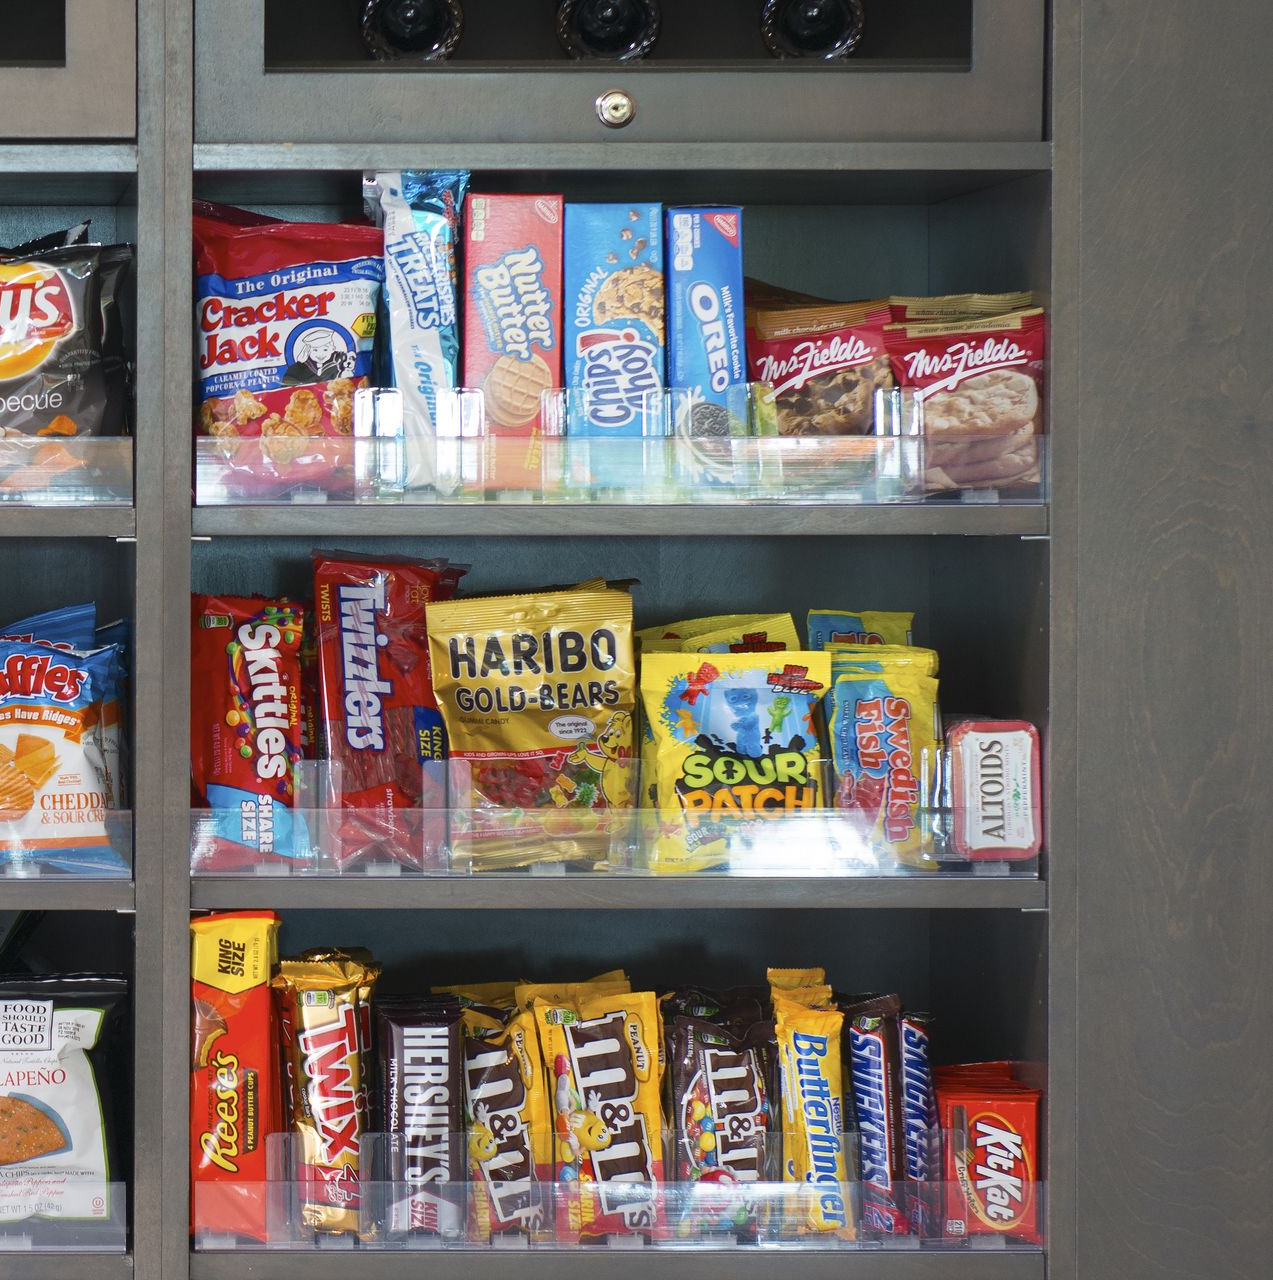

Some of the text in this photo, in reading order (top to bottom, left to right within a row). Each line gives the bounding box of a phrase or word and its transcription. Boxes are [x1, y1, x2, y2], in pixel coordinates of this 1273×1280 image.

[235, 280, 265, 295] The
[271, 265, 338, 288] Original
[386, 232, 441, 330] TREATS
[505, 248, 554, 350] Nutter
[574, 267, 610, 328] ORIGINAL
[201, 291, 336, 332] Cracker
[477, 263, 530, 361] Butter
[720, 285, 741, 380] Milk's Favorite Cookie
[200, 326, 282, 369] Jack
[691, 282, 730, 394] OREO
[588, 348, 632, 425] Chips
[321, 584, 331, 623] TWISTS
[339, 578, 393, 753] Twizzlers
[448, 629, 618, 680] HARIBO
[14, 707, 39, 720] Have
[40, 709, 80, 727] Ridges
[238, 622, 290, 781] Skittles
[455, 680, 621, 714] GOLD-BEARS
[418, 729, 430, 758] SIZE
[432, 725, 442, 762] KING
[567, 721, 588, 729] original
[855, 698, 888, 769] Fish
[682, 751, 809, 788] SOUR
[884, 697, 920, 842] Swedish
[979, 739, 1007, 841] ALTOIDS
[241, 799, 256, 841] SIZE
[258, 793, 275, 853] SHARE
[679, 784, 816, 826] PATCH
[217, 938, 232, 976] KING
[231, 941, 246, 977] SIZE
[2, 1014, 47, 1023] SHOULD
[2, 1022, 46, 1033] TASTE
[4, 1003, 47, 1015] FOOD
[1, 1033, 45, 1046] GOOD
[247, 1071, 255, 1090] CUPS
[299, 1006, 361, 1165] TWIX
[199, 1050, 240, 1174] Reese's
[247, 1090, 256, 1116] BUTTER
[389, 1058, 400, 1154] MILK CHOCOLATE
[403, 1027, 450, 1186] HERSHEY'S
[849, 1027, 892, 1191] SNICKERS
[247, 1116, 256, 1144] PEANUT
[793, 1029, 847, 1228] Butterfinger
[5, 1170, 29, 1179] CHIPS
[976, 1121, 1023, 1221] Kit Kat
[568, 1199, 580, 1229] SIZE
